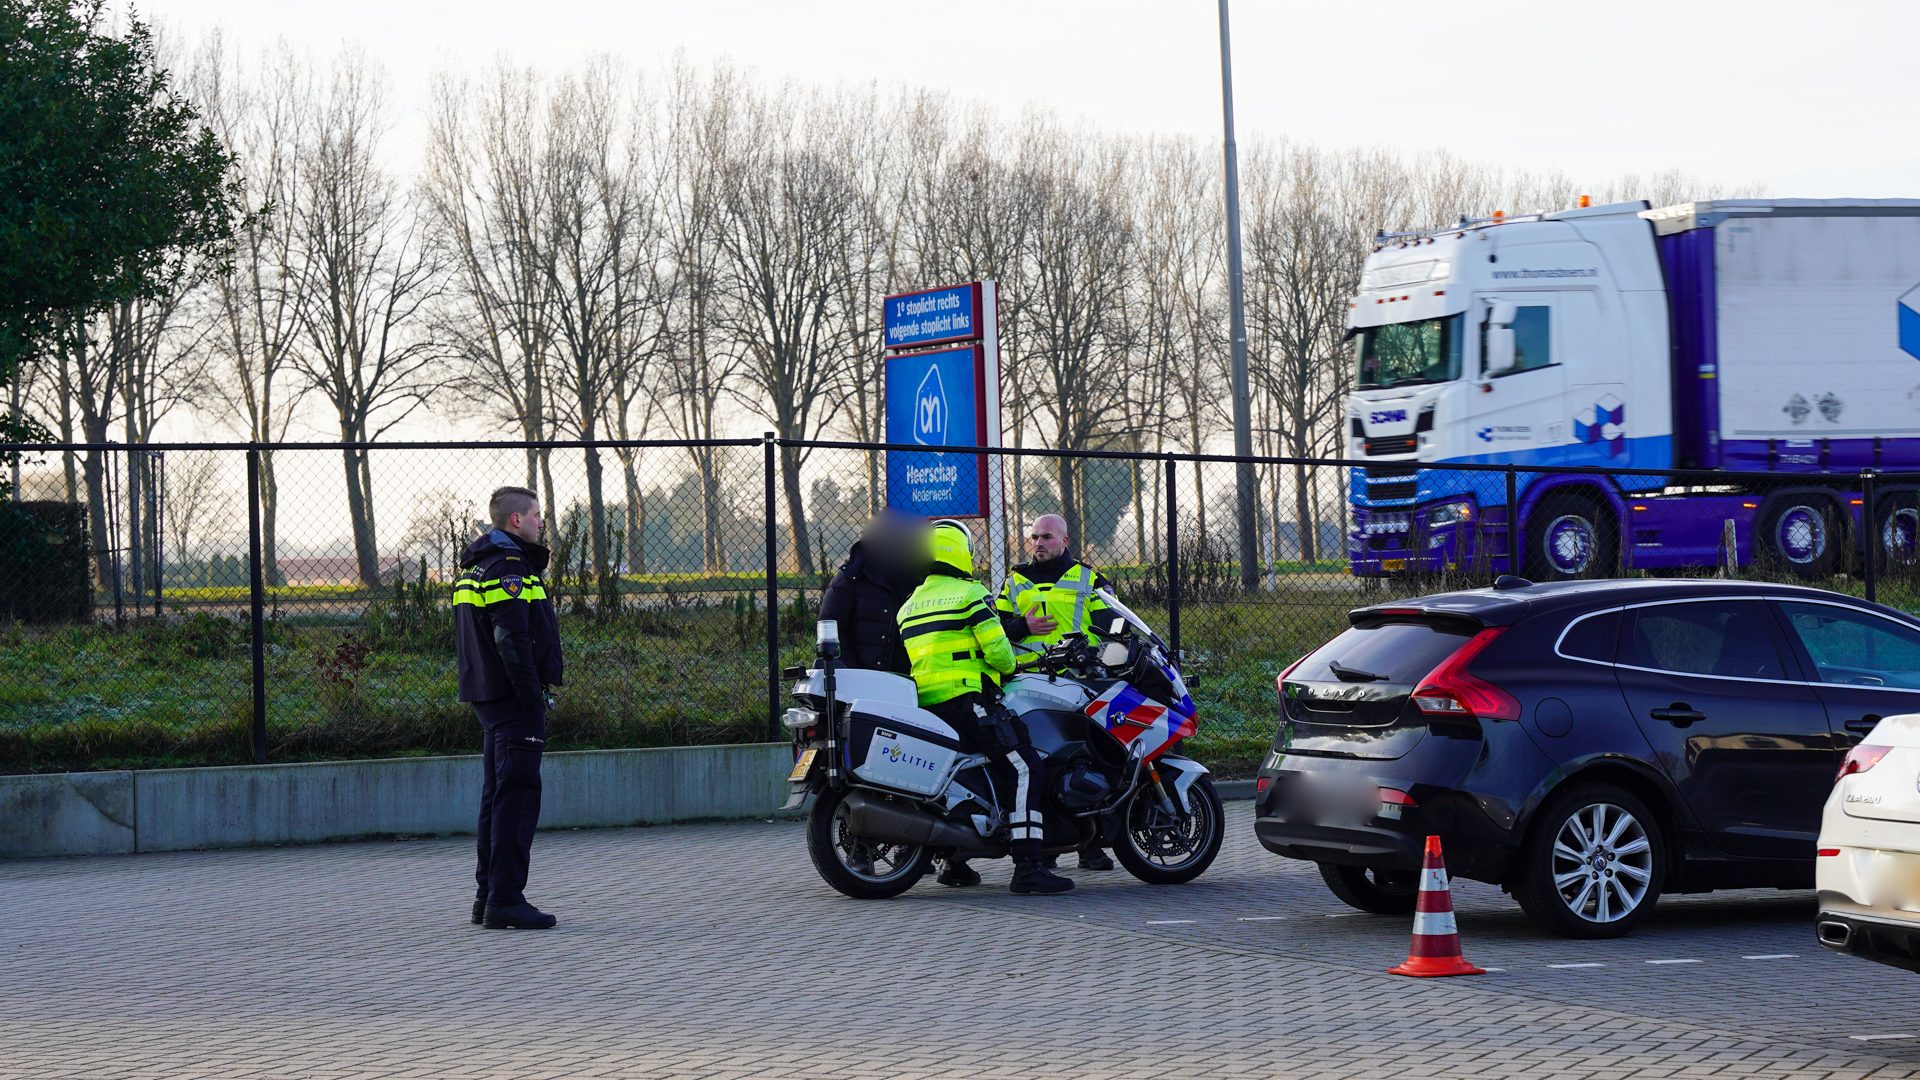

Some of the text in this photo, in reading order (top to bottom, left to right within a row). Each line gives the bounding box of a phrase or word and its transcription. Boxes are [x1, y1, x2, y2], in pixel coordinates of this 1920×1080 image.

[906, 296, 936, 317] stoplicht
[937, 292, 960, 311] rechts
[889, 312, 969, 341] volgende stoplicht links
[1370, 409, 1408, 424] SCANIA
[906, 462, 958, 487] Heerschap
[912, 486, 952, 502] Nederweert
[1295, 687, 1366, 697] VOLVO
[880, 730, 893, 738] BMW
[882, 744, 935, 771] POLITIE
